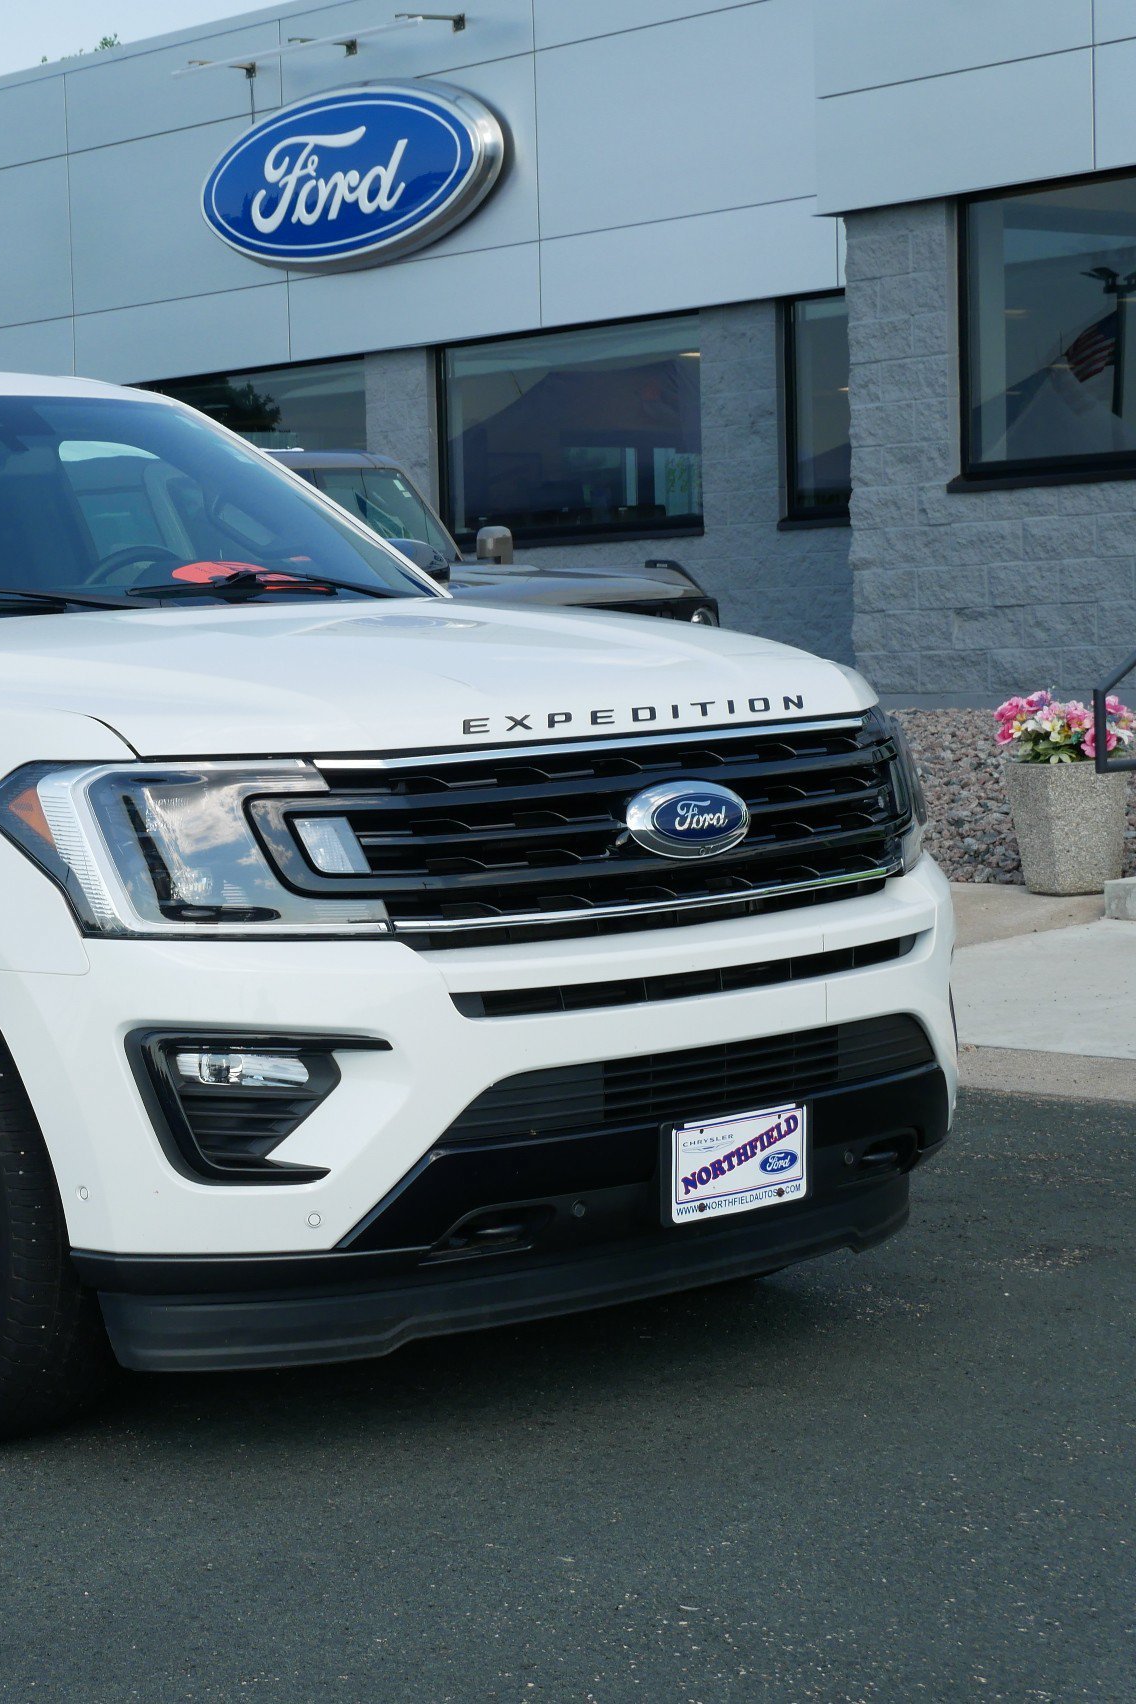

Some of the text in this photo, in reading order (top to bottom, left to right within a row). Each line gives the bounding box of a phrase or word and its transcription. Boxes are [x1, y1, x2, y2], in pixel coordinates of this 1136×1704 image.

[251, 125, 409, 234] Ford
[462, 694, 805, 735] EXPEDITION
[674, 800, 729, 831] Ford
[681, 1114, 800, 1196] NORTHFIELD
[682, 1133, 734, 1148] CHRYSLER
[766, 1153, 791, 1171] Ford
[676, 1183, 801, 1217] WWWNORTHFIELDAUTOSCOM
